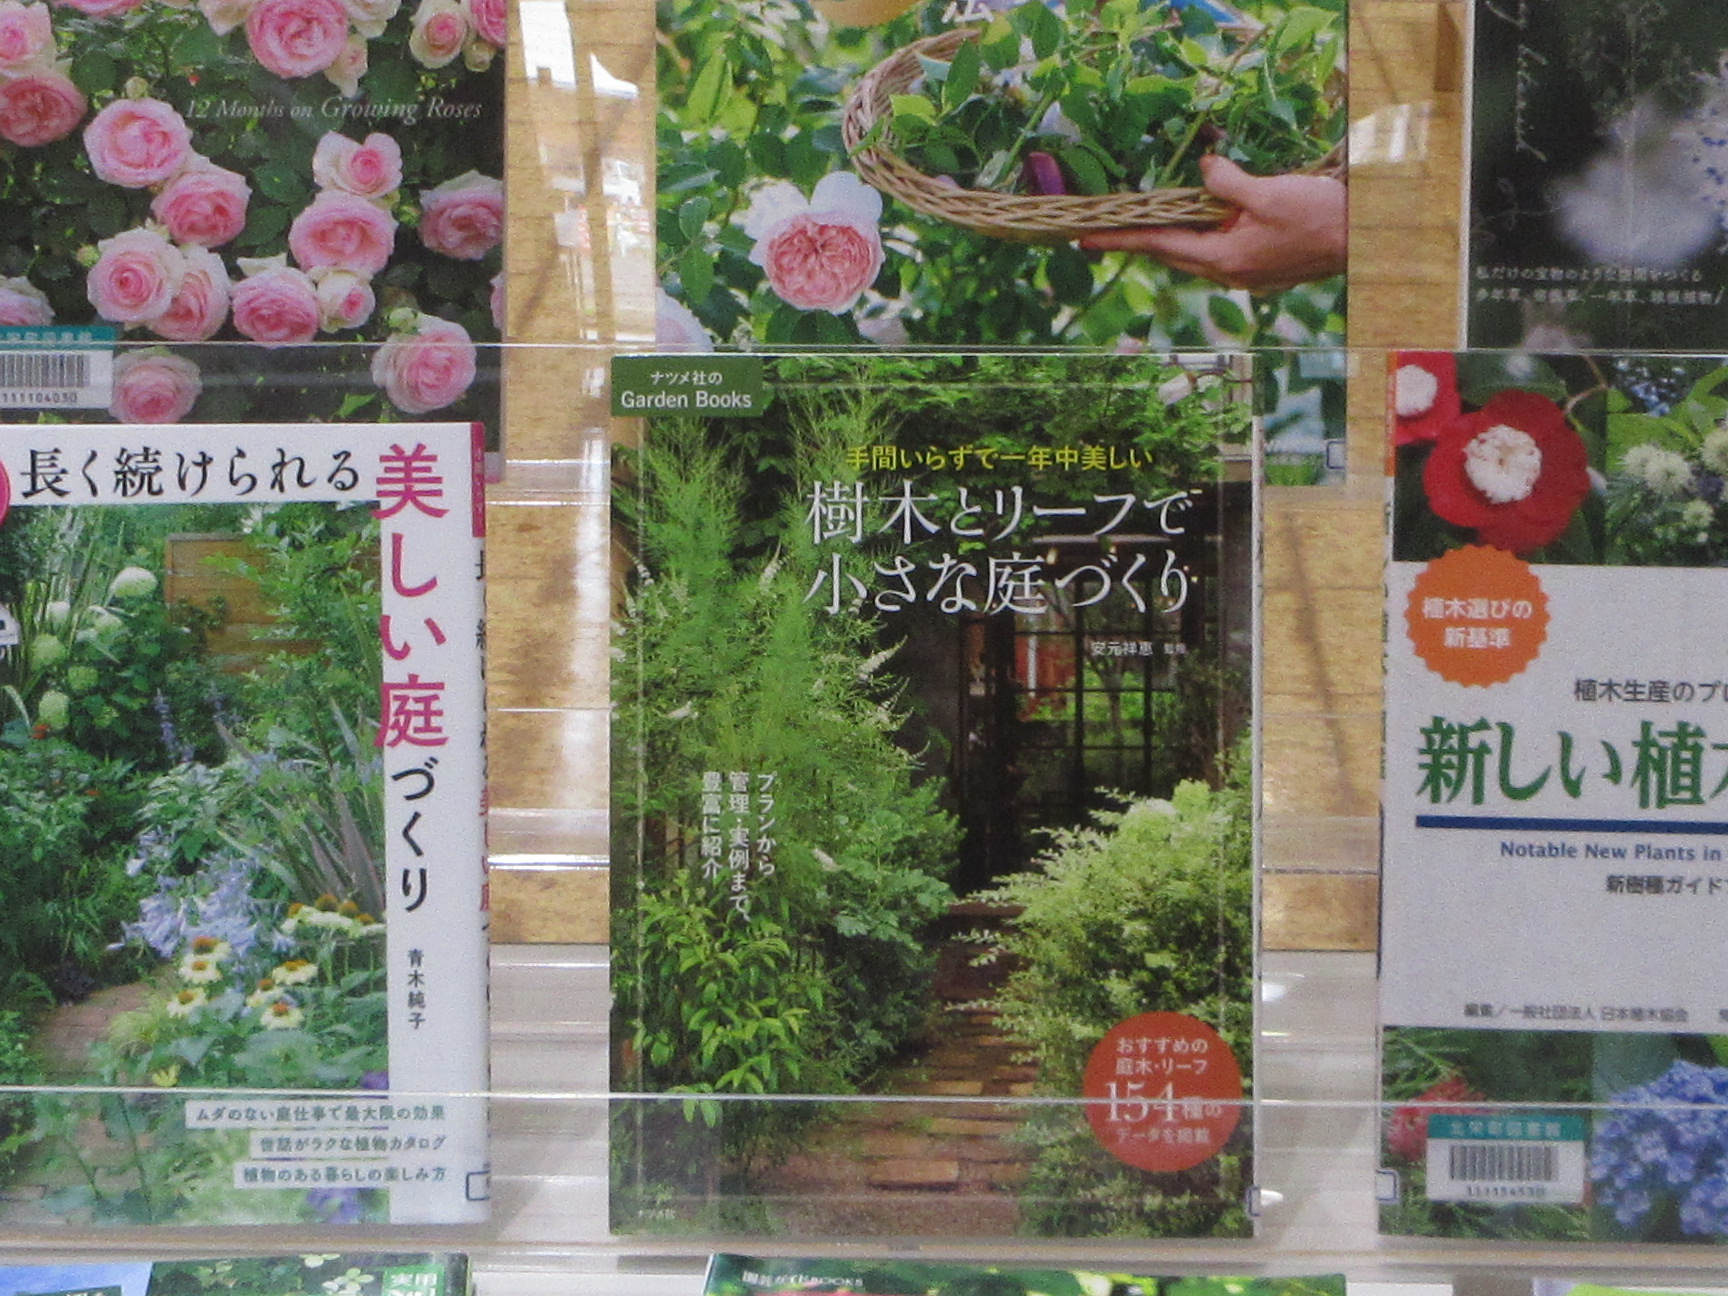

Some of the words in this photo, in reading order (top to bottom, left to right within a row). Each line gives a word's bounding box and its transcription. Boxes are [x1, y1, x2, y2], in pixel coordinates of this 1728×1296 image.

[186, 100, 211, 119] 12
[216, 99, 287, 120] Months
[321, 98, 417, 125] Growing
[430, 99, 483, 120] Roses
[650, 369, 723, 387] ナツメ社の
[621, 390, 689, 409] Garden
[695, 390, 753, 409] Books
[845, 445, 1155, 471] 手間いらずで一年中美しい
[20, 445, 360, 501] 長く続けられる
[803, 480, 1204, 546] 樹木とリーフで
[802, 550, 1191, 616] 小さな庭づくり
[1422, 597, 1533, 621] 植木選びの
[1443, 627, 1512, 650] 新基準
[370, 442, 451, 914] 美しい庭づくり
[700, 770, 723, 881] 豊富に紹介
[756, 770, 776, 879] プランから
[1500, 841, 1578, 860] Notable
[1585, 843, 1627, 860] New
[1634, 843, 1696, 862] Plants
[1703, 844, 1722, 862] in
[406, 948, 426, 1031] 青木純子
[1115, 1036, 1209, 1056] おすすめの
[1115, 1058, 1209, 1077] 庭木・リーフ
